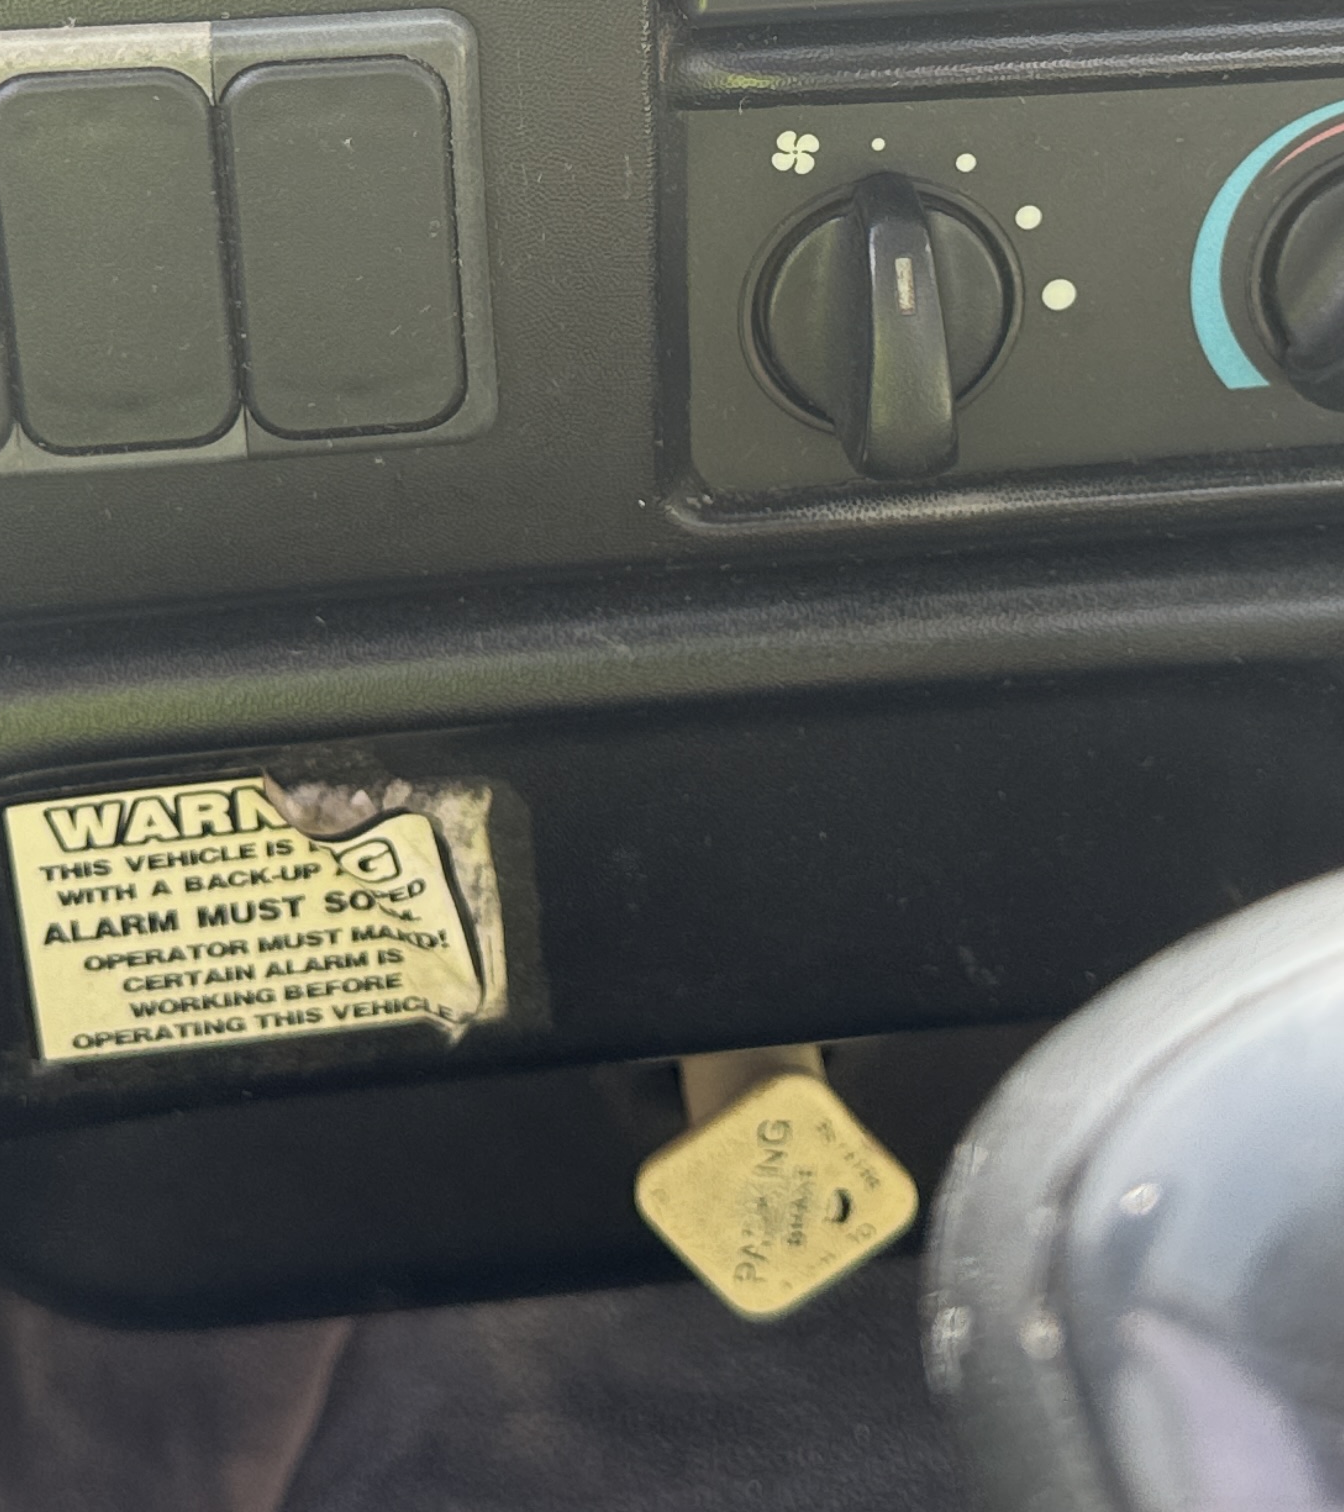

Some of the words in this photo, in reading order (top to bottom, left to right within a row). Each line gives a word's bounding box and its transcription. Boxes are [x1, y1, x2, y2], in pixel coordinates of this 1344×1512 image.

[39, 859, 113, 881] THIS
[124, 842, 258, 872] VEHICLE
[267, 839, 294, 857] IS
[57, 883, 137, 906] WITH
[151, 879, 173, 896] A
[184, 862, 322, 893] BACK-UP
[43, 909, 180, 946] ALARM
[197, 895, 306, 928] MUST
[83, 938, 250, 971] OPERATOR
[258, 926, 343, 952] MUST
[122, 964, 256, 992] CERTAIN
[265, 950, 370, 978] ALARM
[377, 948, 406, 966] IS
[129, 986, 277, 1018] WORKING
[284, 972, 404, 1001] BEFORE
[72, 1016, 247, 1050] OPERATING
[253, 1007, 324, 1029] THIS
[733, 1118, 794, 1285] PAING
